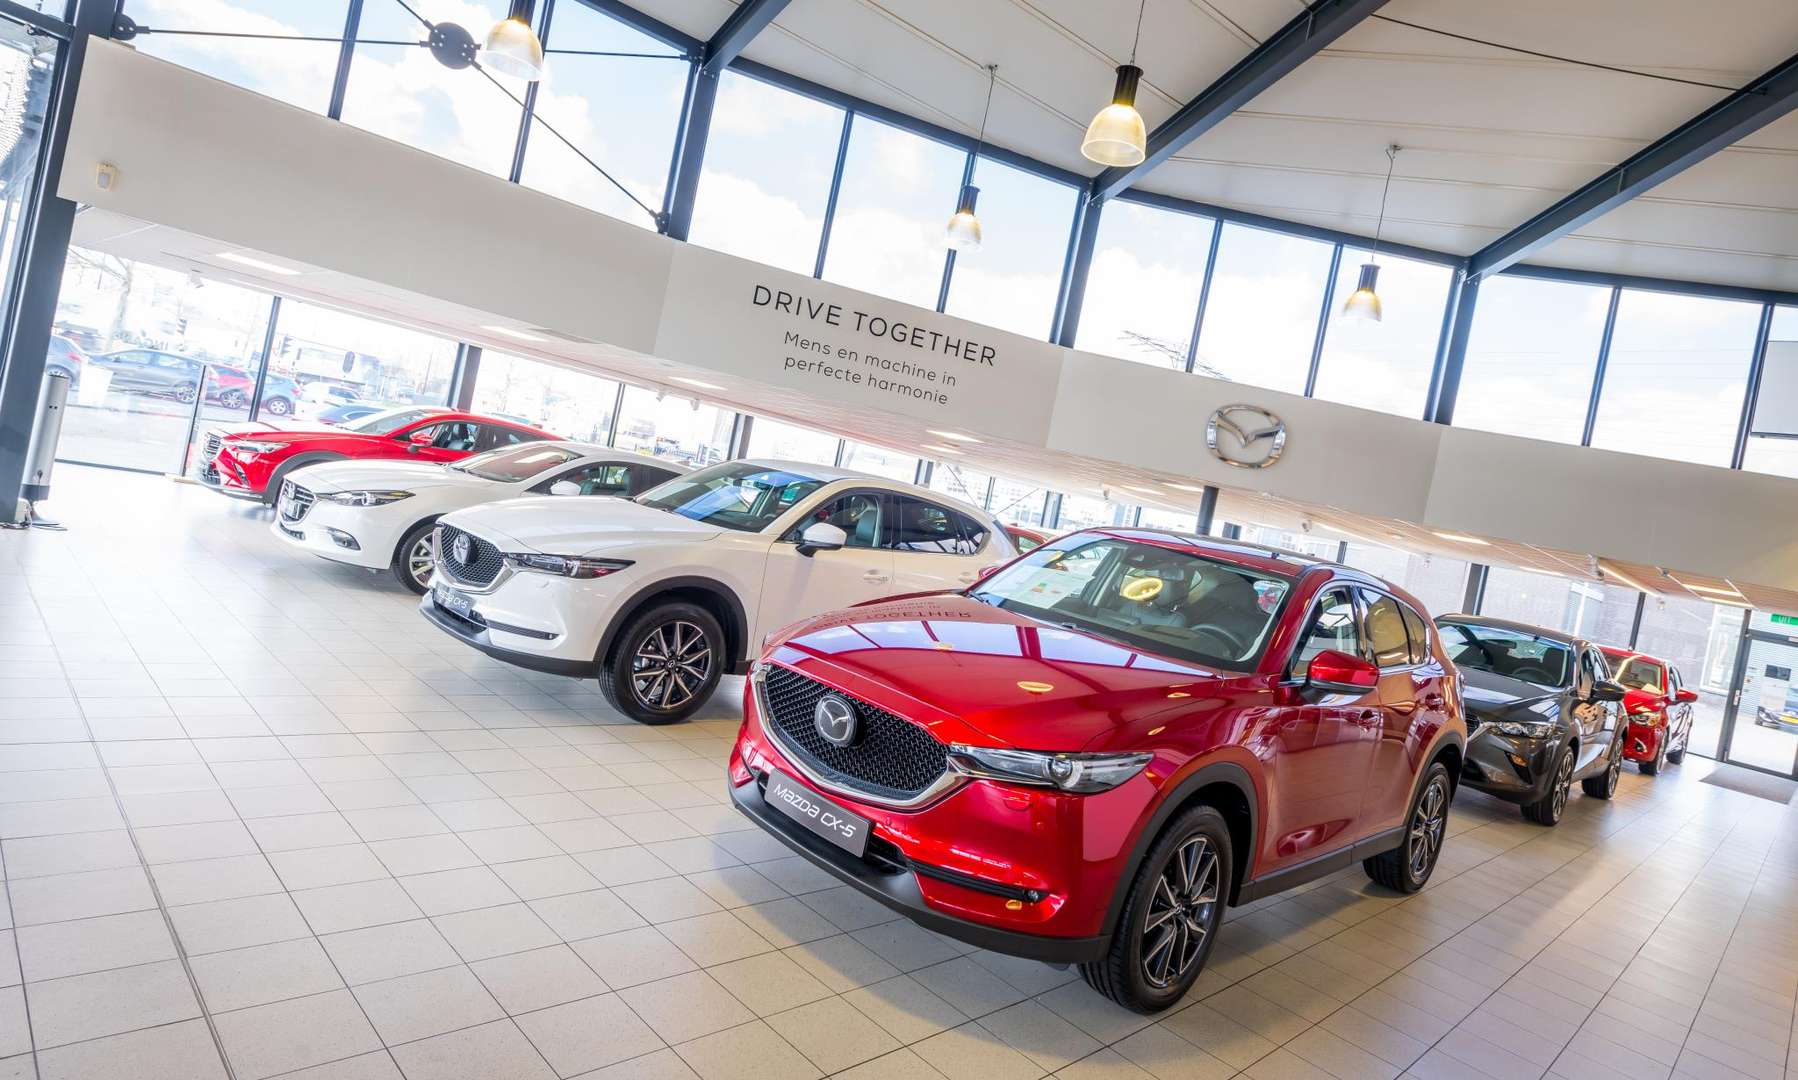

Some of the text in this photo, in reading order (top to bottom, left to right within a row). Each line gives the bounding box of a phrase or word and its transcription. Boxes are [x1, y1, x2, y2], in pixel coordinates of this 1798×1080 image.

[752, 284, 996, 367] DRIVE TOGETHER
[784, 331, 956, 386] Mens en machine in
[784, 357, 948, 405] perfecte harmonie
[820, 812, 856, 838] CX-5
